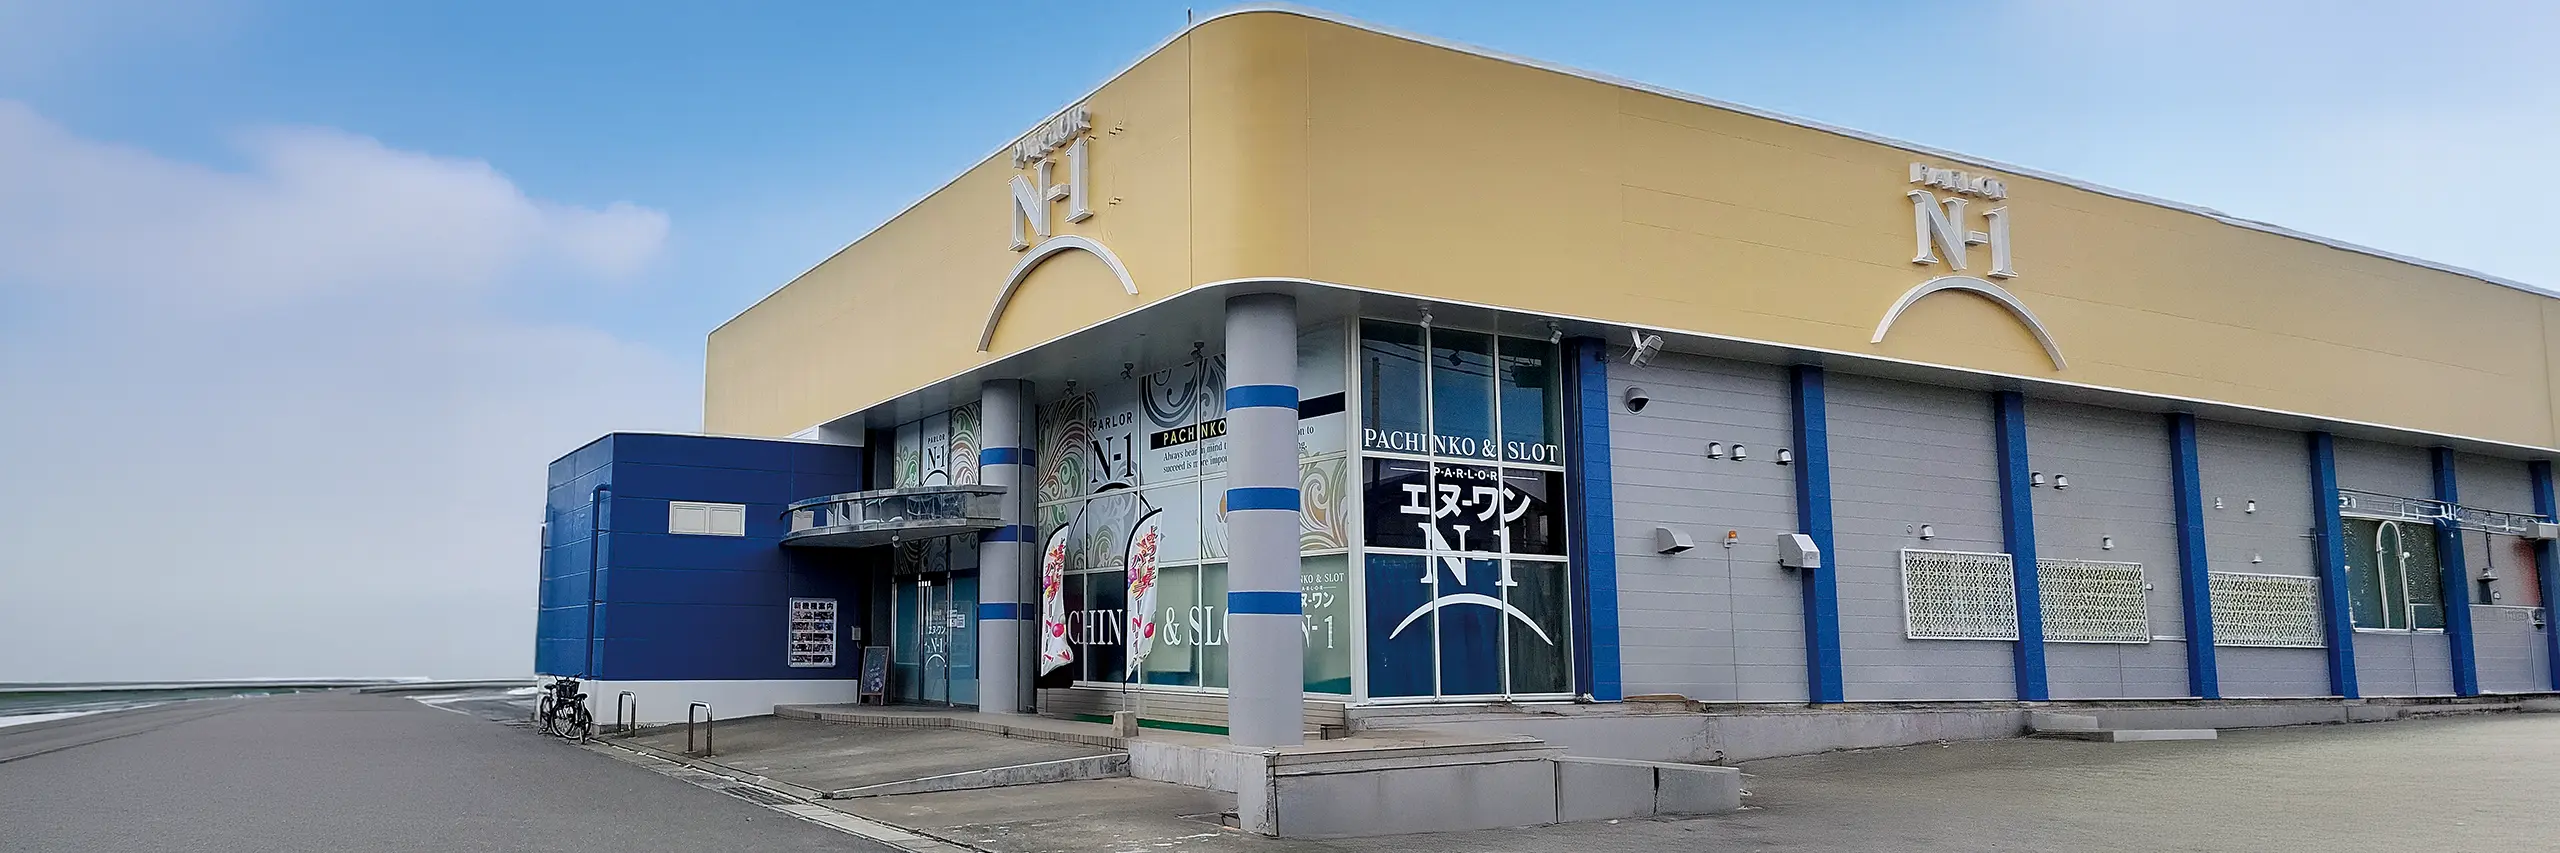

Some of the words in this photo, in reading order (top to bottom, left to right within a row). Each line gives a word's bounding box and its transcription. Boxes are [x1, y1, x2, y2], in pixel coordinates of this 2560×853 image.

[1008, 137, 1093, 252] N-1
[1909, 162, 2008, 200] PARLOR
[1907, 189, 2018, 278] N-1
[1091, 412, 1133, 432] PARLOR
[1163, 419, 1227, 446] PACHNKO
[926, 444, 945, 471] N-1
[1091, 431, 1134, 483] N-1
[1364, 428, 1475, 456] PACHINKO
[1482, 438, 1498, 458] &
[1507, 441, 1558, 463] SLOT
[1418, 522, 1518, 587] N-1
[1324, 572, 1345, 583] SLOT
[1163, 606, 1182, 646] &
